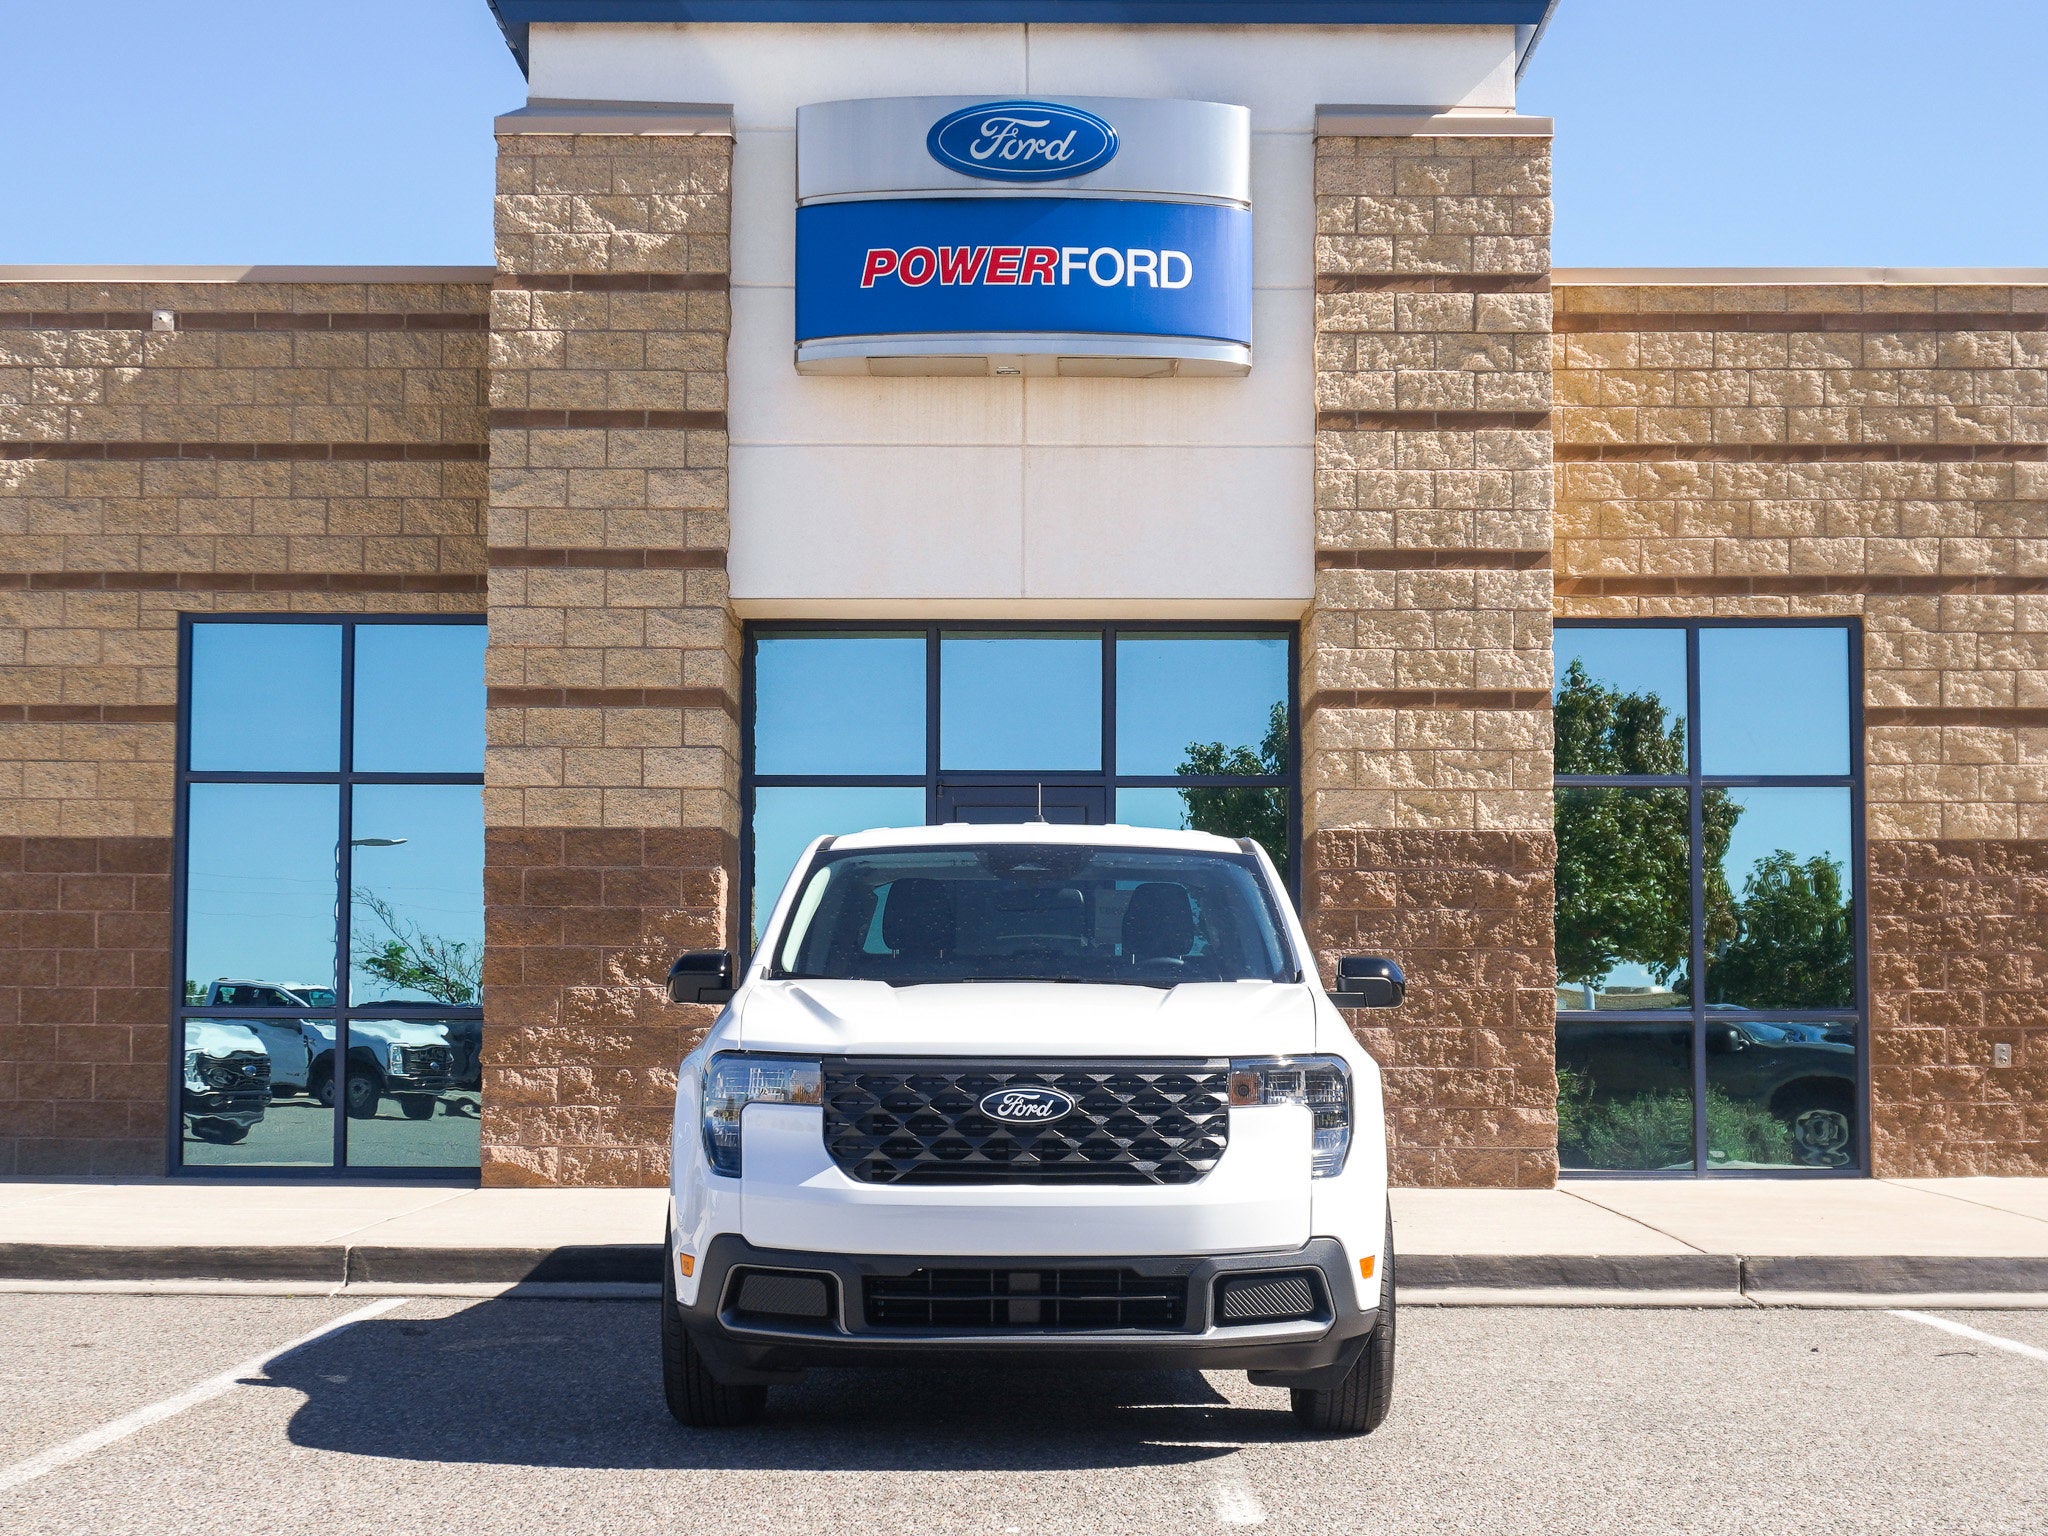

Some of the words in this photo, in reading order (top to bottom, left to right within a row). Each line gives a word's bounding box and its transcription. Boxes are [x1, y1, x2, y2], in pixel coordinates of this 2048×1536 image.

[970, 116, 1075, 161] Ford
[860, 246, 1193, 289] POWERFORD
[997, 1093, 1054, 1117] Ford
